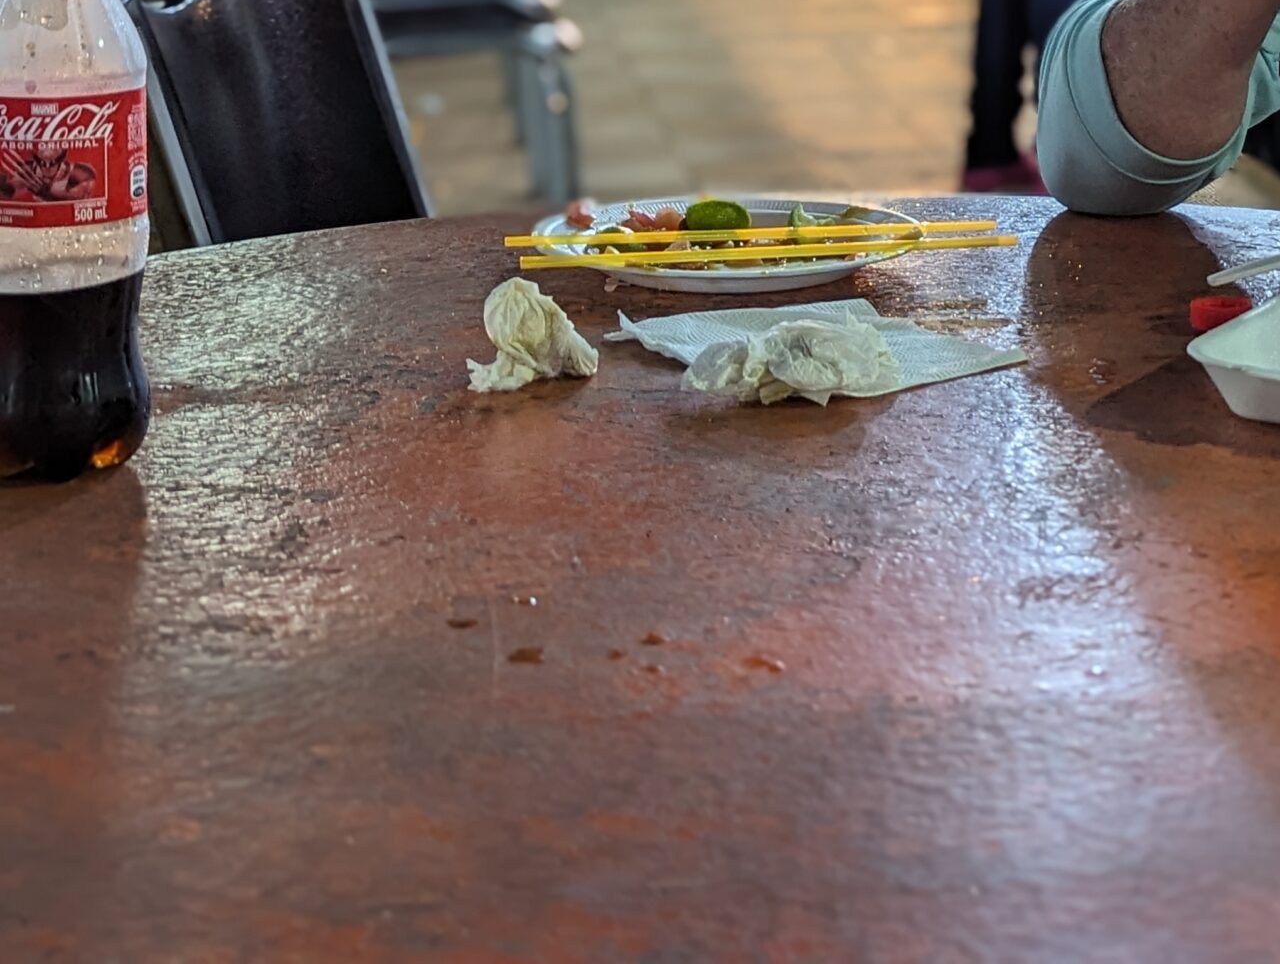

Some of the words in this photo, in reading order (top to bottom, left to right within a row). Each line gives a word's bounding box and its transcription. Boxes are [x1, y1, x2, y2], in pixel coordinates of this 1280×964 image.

[1, 140, 34, 151] ABOR
[38, 139, 99, 150] ORIGINAL
[74, 208, 93, 222] 500
